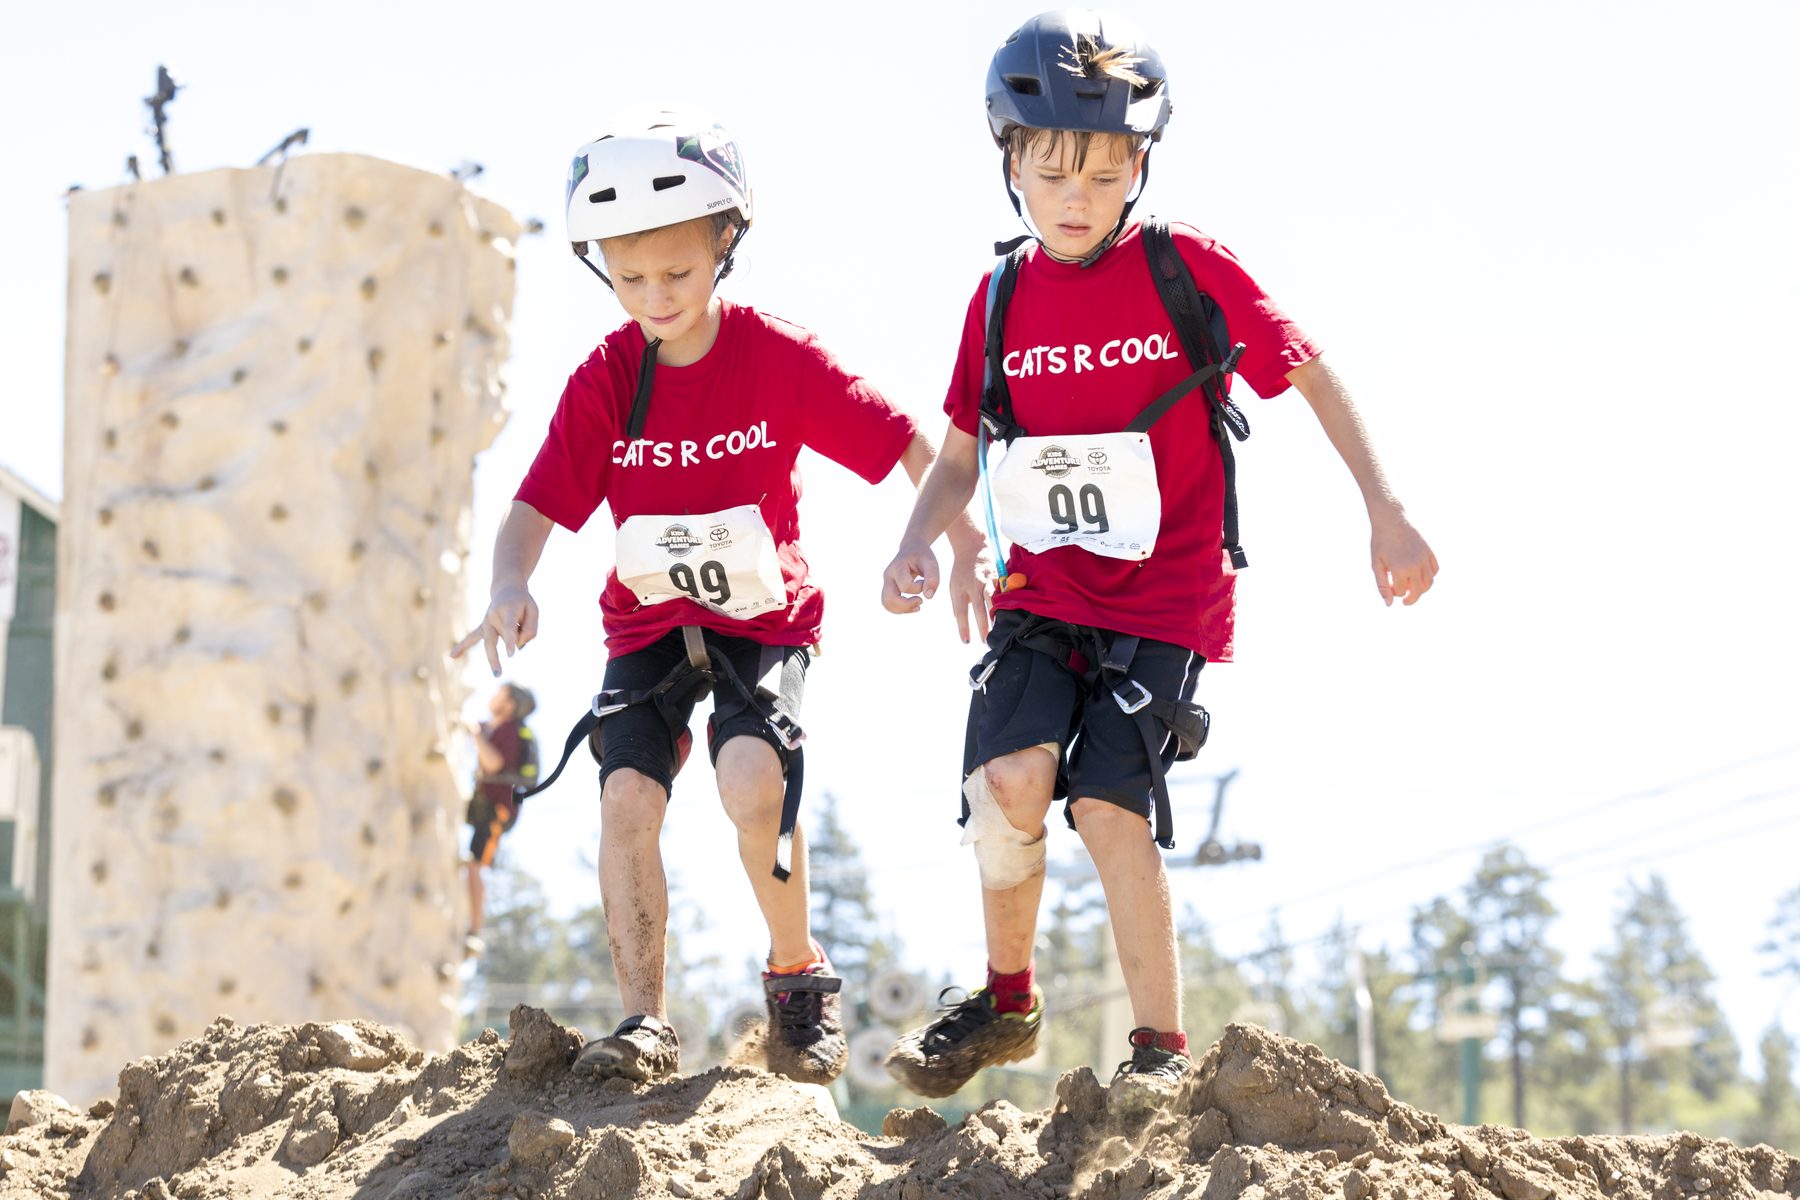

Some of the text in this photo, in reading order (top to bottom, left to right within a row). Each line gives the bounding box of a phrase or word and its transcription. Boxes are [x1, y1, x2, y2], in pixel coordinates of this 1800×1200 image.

[707, 199, 726, 209] SUPPLY
[1002, 331, 1178, 378] CATS R COOL
[612, 421, 776, 468] CATS R COOL
[1032, 457, 1081, 467] ADVENTURE
[1048, 483, 1110, 534] 99
[656, 535, 703, 545] ADVENTURE
[709, 540, 733, 548] TOYOTA
[669, 560, 731, 607] 99
